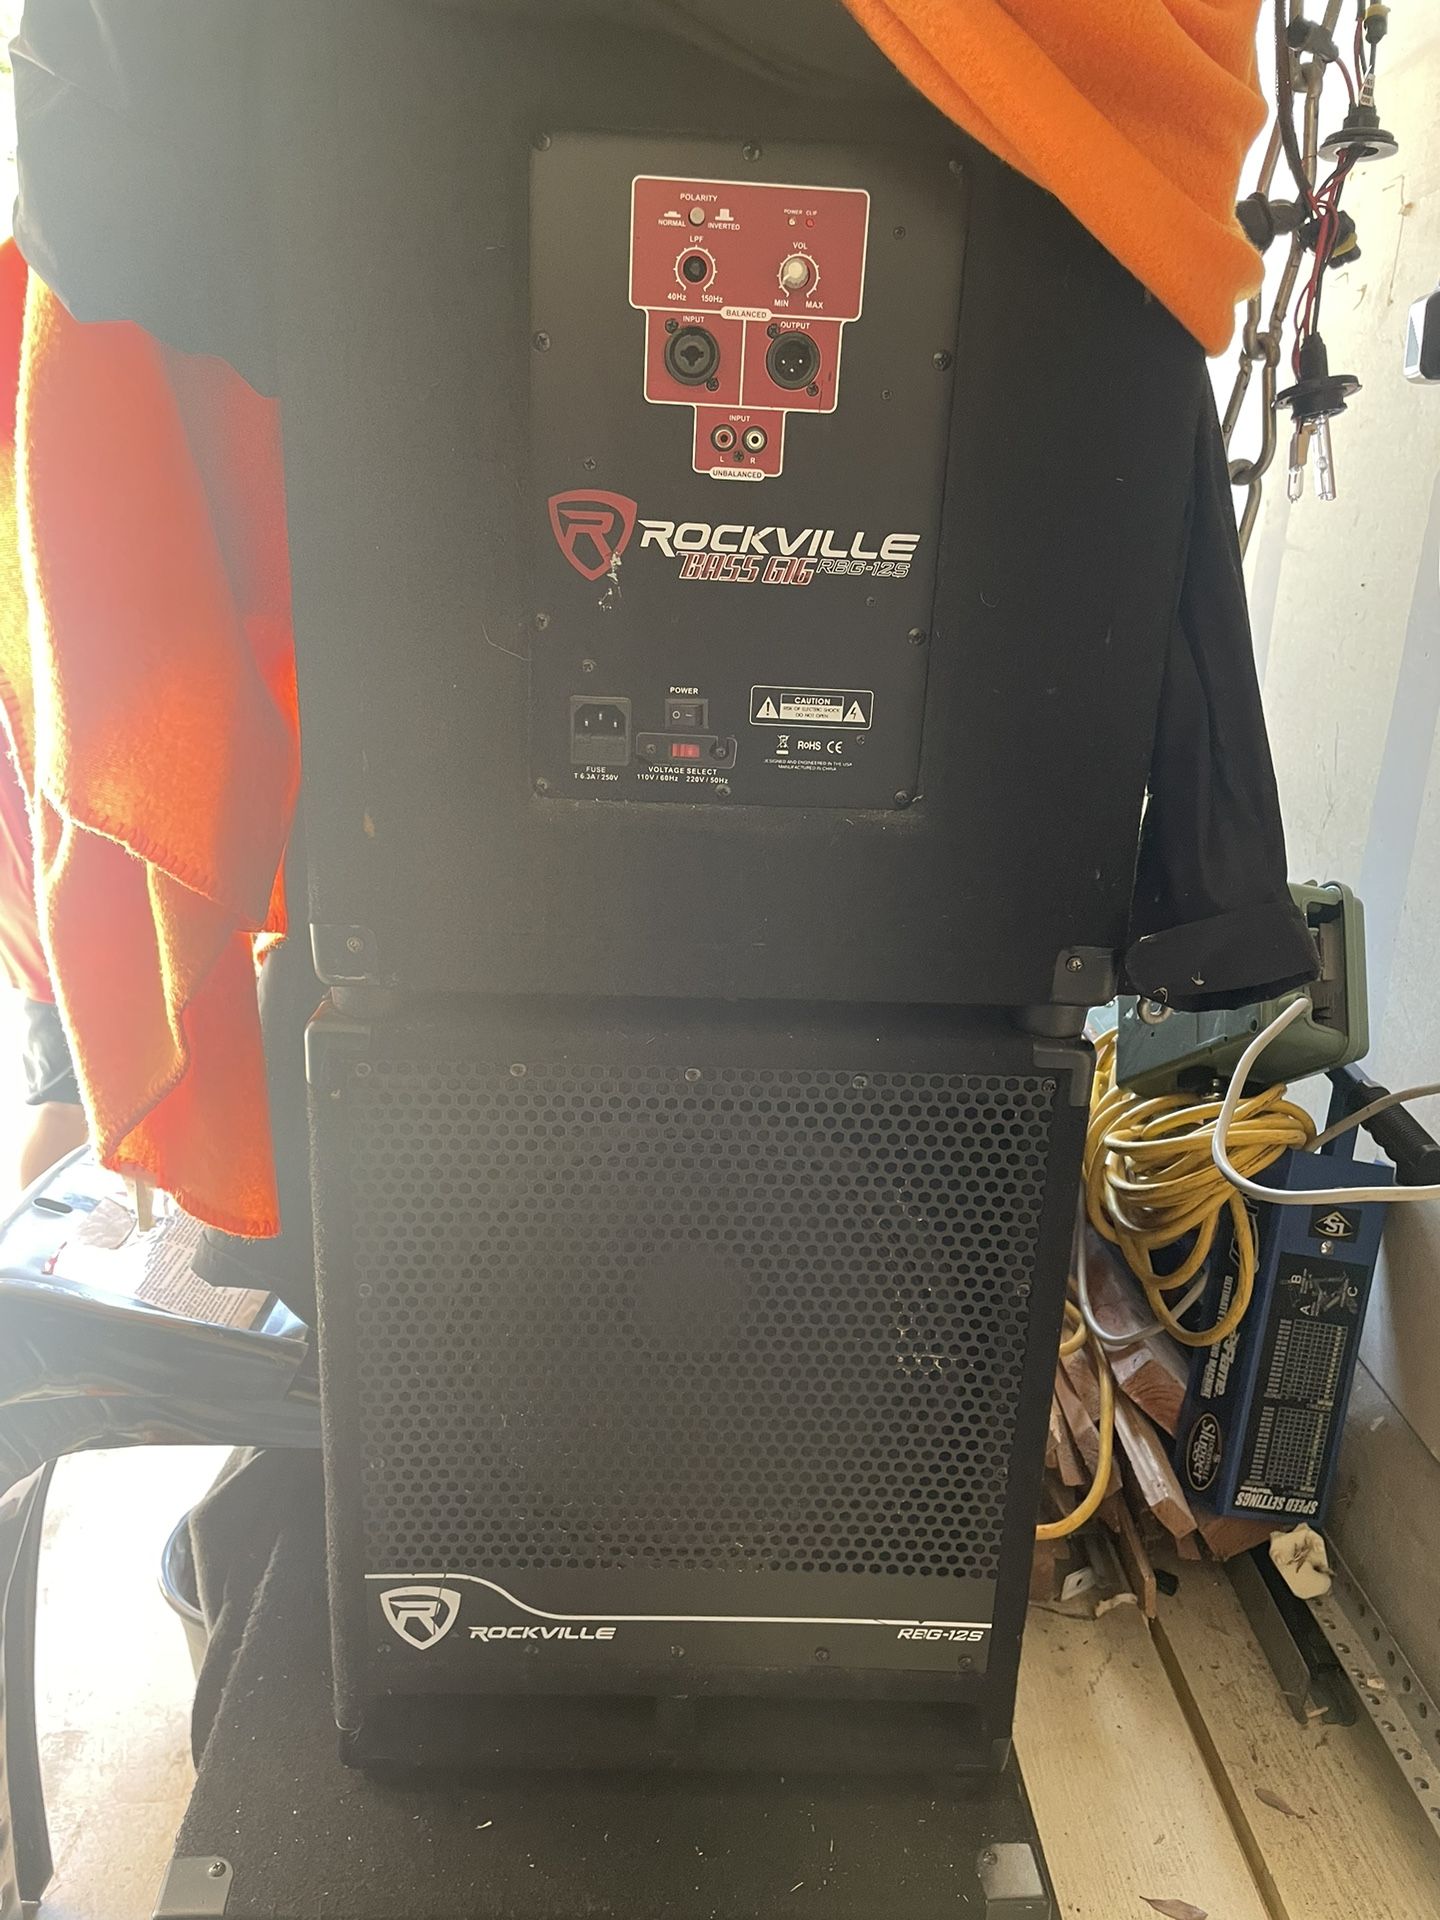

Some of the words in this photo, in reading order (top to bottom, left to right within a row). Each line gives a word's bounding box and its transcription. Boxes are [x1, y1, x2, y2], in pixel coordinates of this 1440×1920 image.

[680, 193, 718, 202] POLARITY
[658, 219, 686, 228] NORMAL
[708, 222, 740, 231] INVERTED
[689, 235, 704, 243] LPF
[792, 242, 808, 250] VOL
[667, 292, 687, 301] 40Hz
[701, 294, 724, 304] 150Hz
[774, 299, 789, 308] MIN
[805, 301, 824, 310] MAX
[726, 310, 767, 318] BALANCED
[682, 315, 704, 324] INPUT
[780, 322, 810, 330] OUTPUT
[712, 470, 762, 479] UNBALANCED
[638, 519, 921, 561] ROCKVILLE
[677, 552, 764, 583] BASS
[816, 558, 911, 579] RBG-12S
[670, 686, 699, 695] POWER
[794, 696, 830, 705] CAUTION
[797, 740, 821, 751] RoHS
[826, 740, 843, 754] CE
[1290, 1274, 1302, 1284] B
[1346, 1286, 1358, 1297] C
[1300, 1304, 1312, 1315] A
[1192, 1420, 1216, 1482] Slugger
[1235, 1492, 1285, 1510] SETTINGS
[1285, 1498, 1318, 1514] SPEED
[468, 1626, 617, 1642] ROCKVILLE
[897, 1628, 984, 1642] RBG-12S
